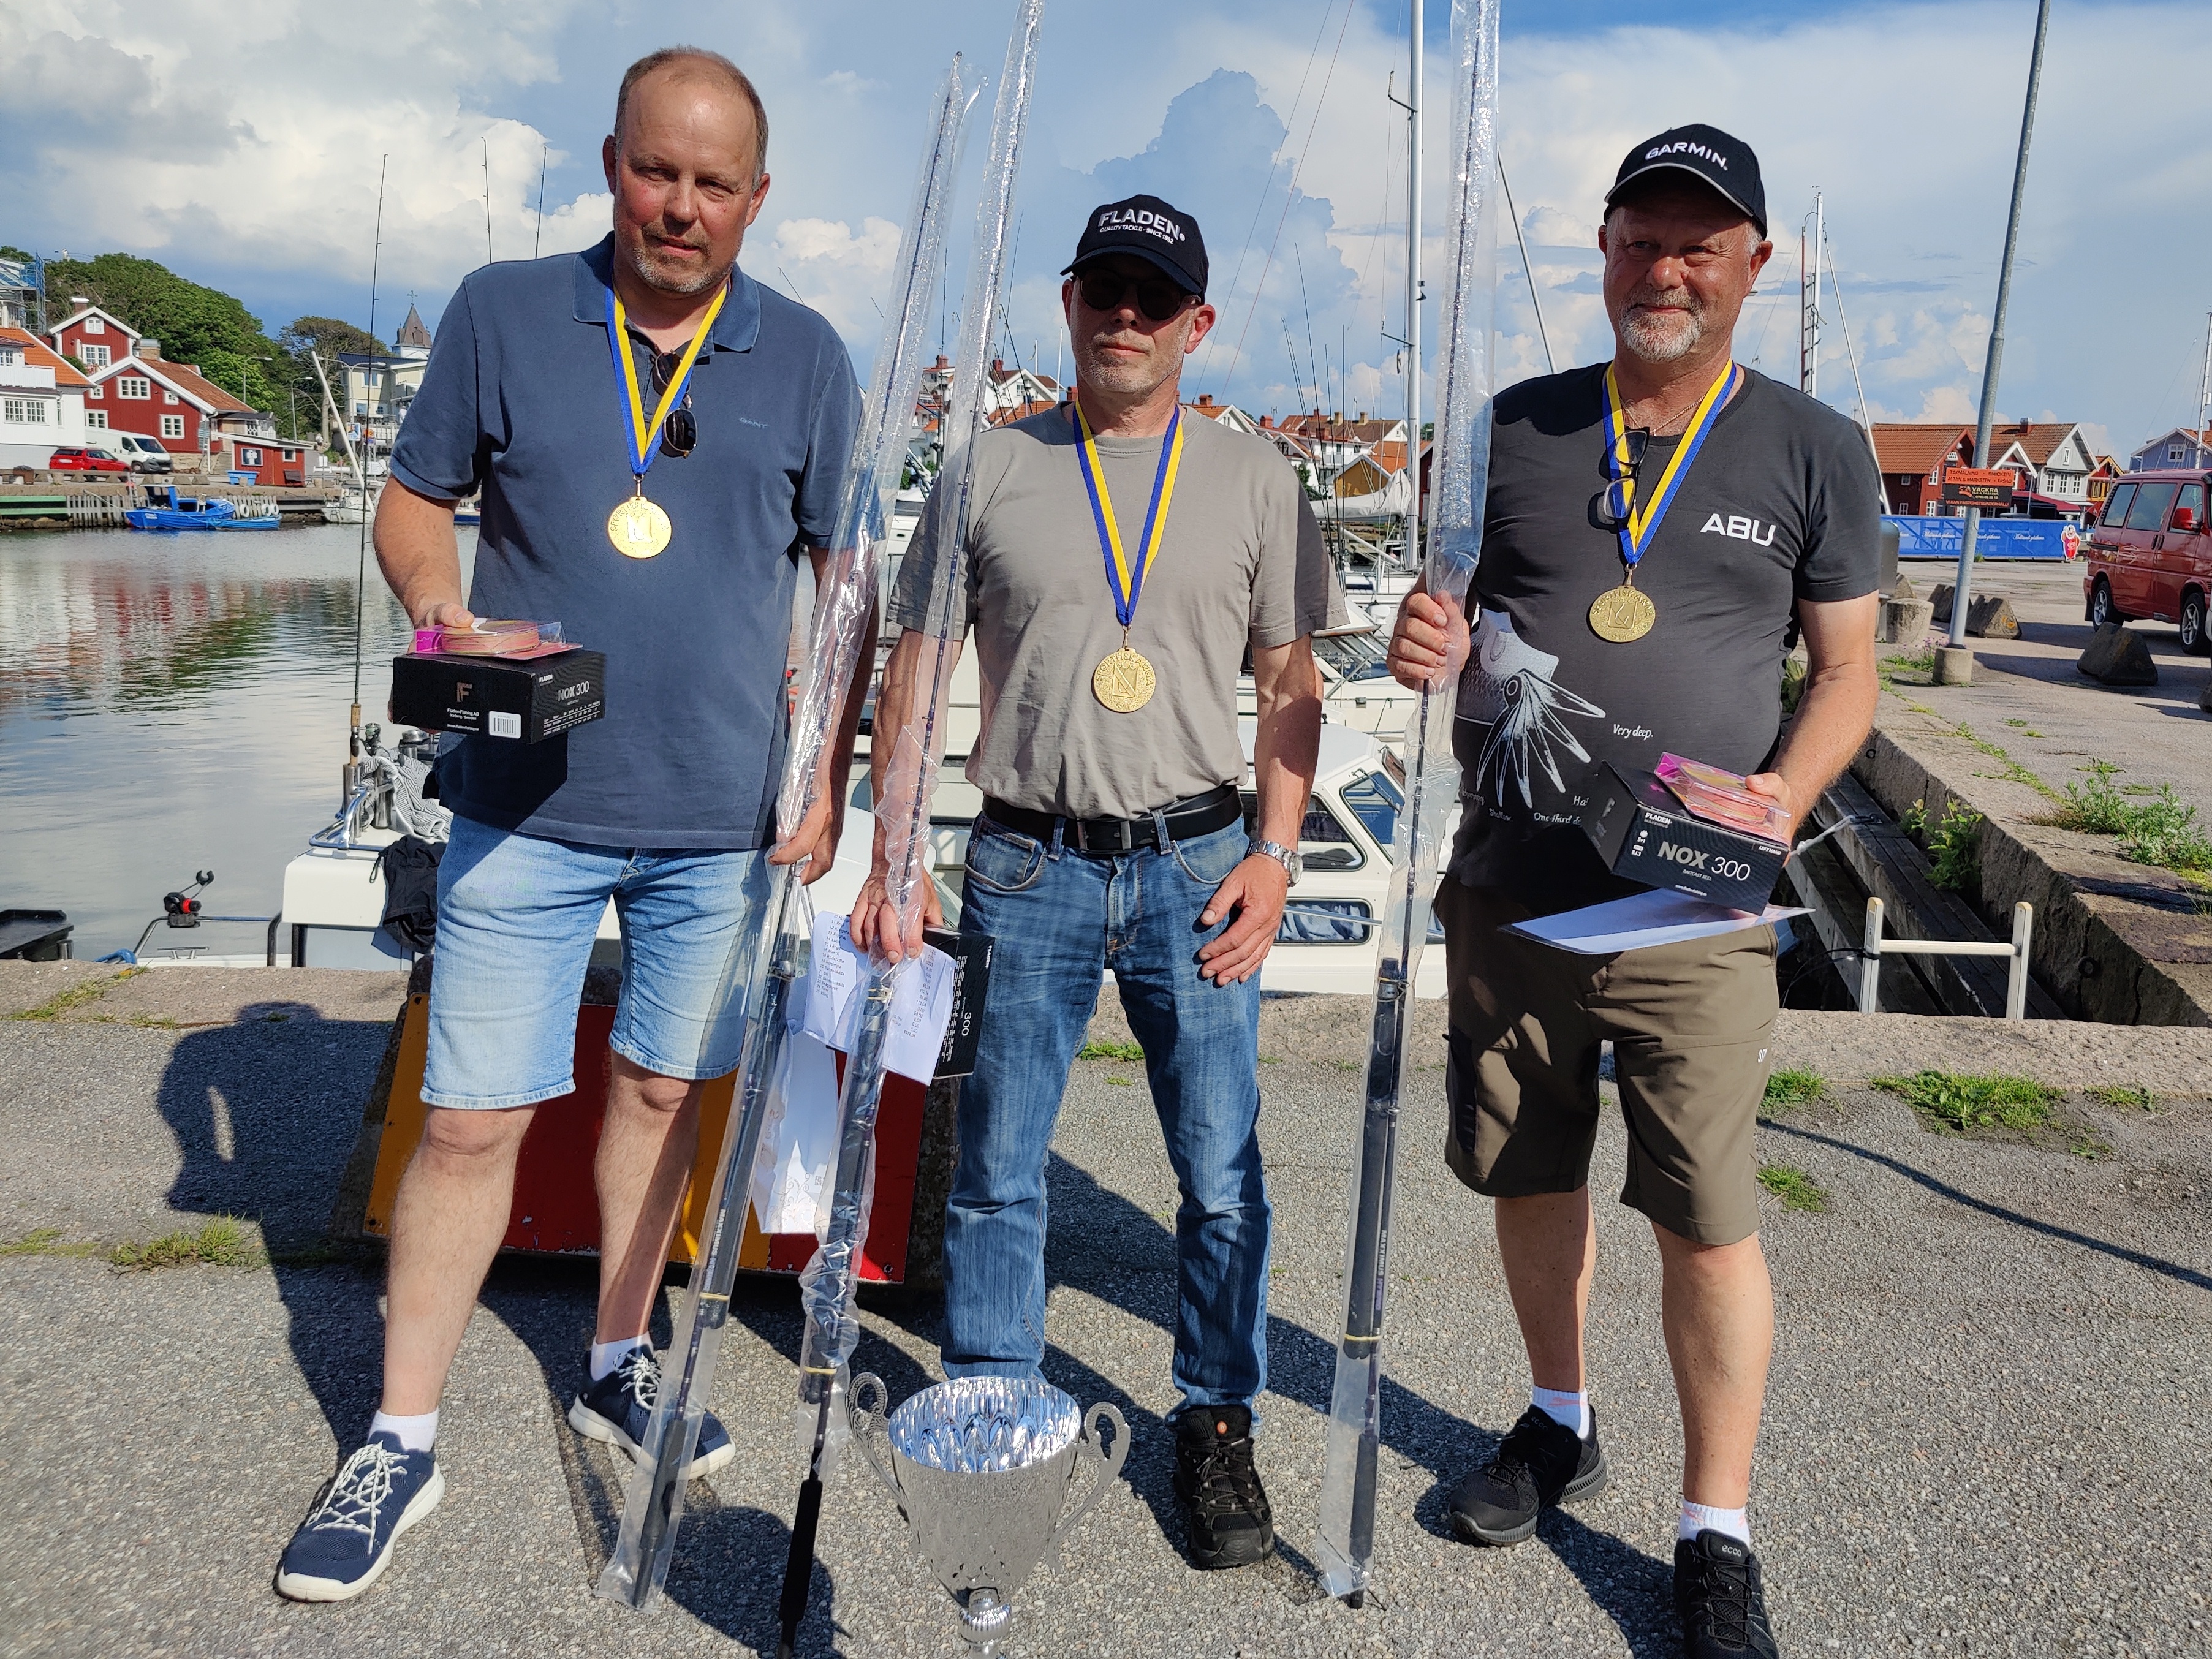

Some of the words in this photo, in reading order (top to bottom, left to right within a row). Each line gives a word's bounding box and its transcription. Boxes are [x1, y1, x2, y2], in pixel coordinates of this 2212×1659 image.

[1146, 227, 1162, 238] SINCE
[1700, 513, 1776, 546] ABU
[558, 686, 575, 701] NOX
[576, 681, 589, 696] 300
[1613, 724, 1632, 739] Very
[1632, 725, 1654, 739] deep.
[1645, 812, 1671, 825] FLADEN
[1657, 841, 1710, 870] NOX
[1711, 856, 1751, 882] 300
[961, 1012, 971, 1037] 300
[1377, 1230, 1387, 1277] MAXXIMUS
